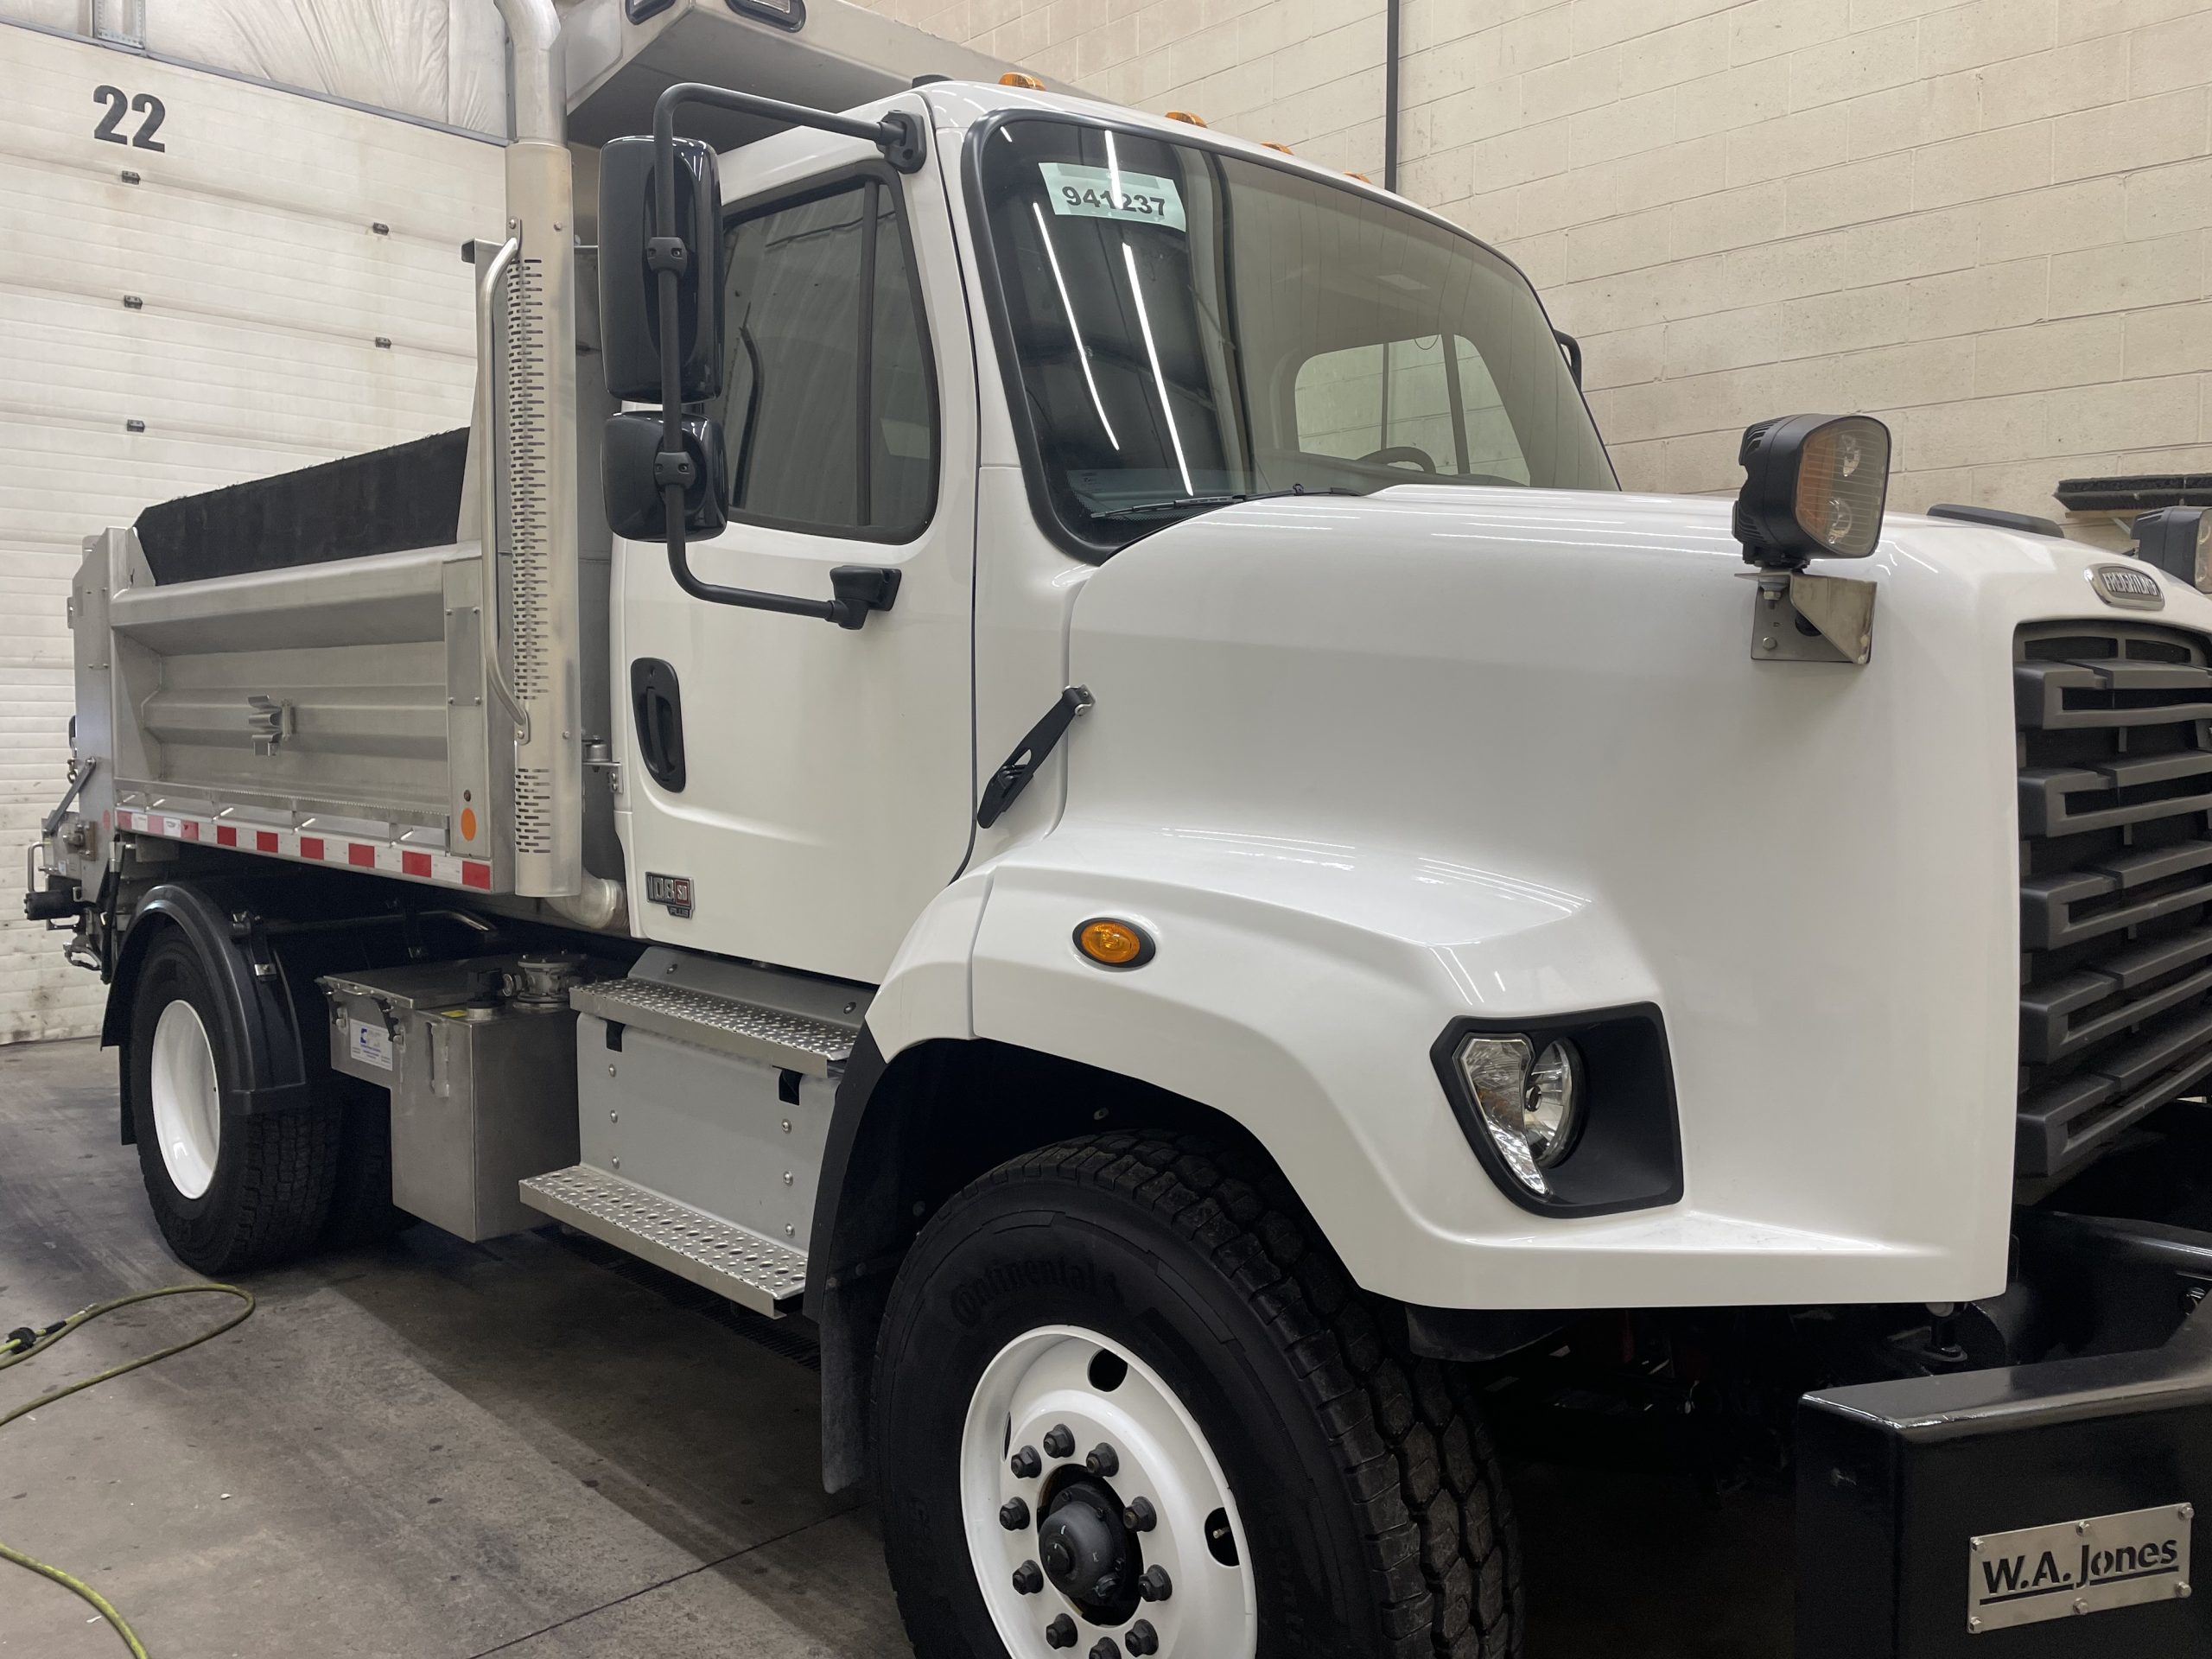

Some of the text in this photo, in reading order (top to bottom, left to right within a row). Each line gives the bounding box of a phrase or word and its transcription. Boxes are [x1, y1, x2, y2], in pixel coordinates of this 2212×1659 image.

[92, 85, 166, 153] 22
[1062, 186, 1165, 216] 941237
[647, 875, 674, 901] 108
[950, 1256, 1097, 1327] Continental
[1982, 1539, 2178, 1594] W.A. Jones
